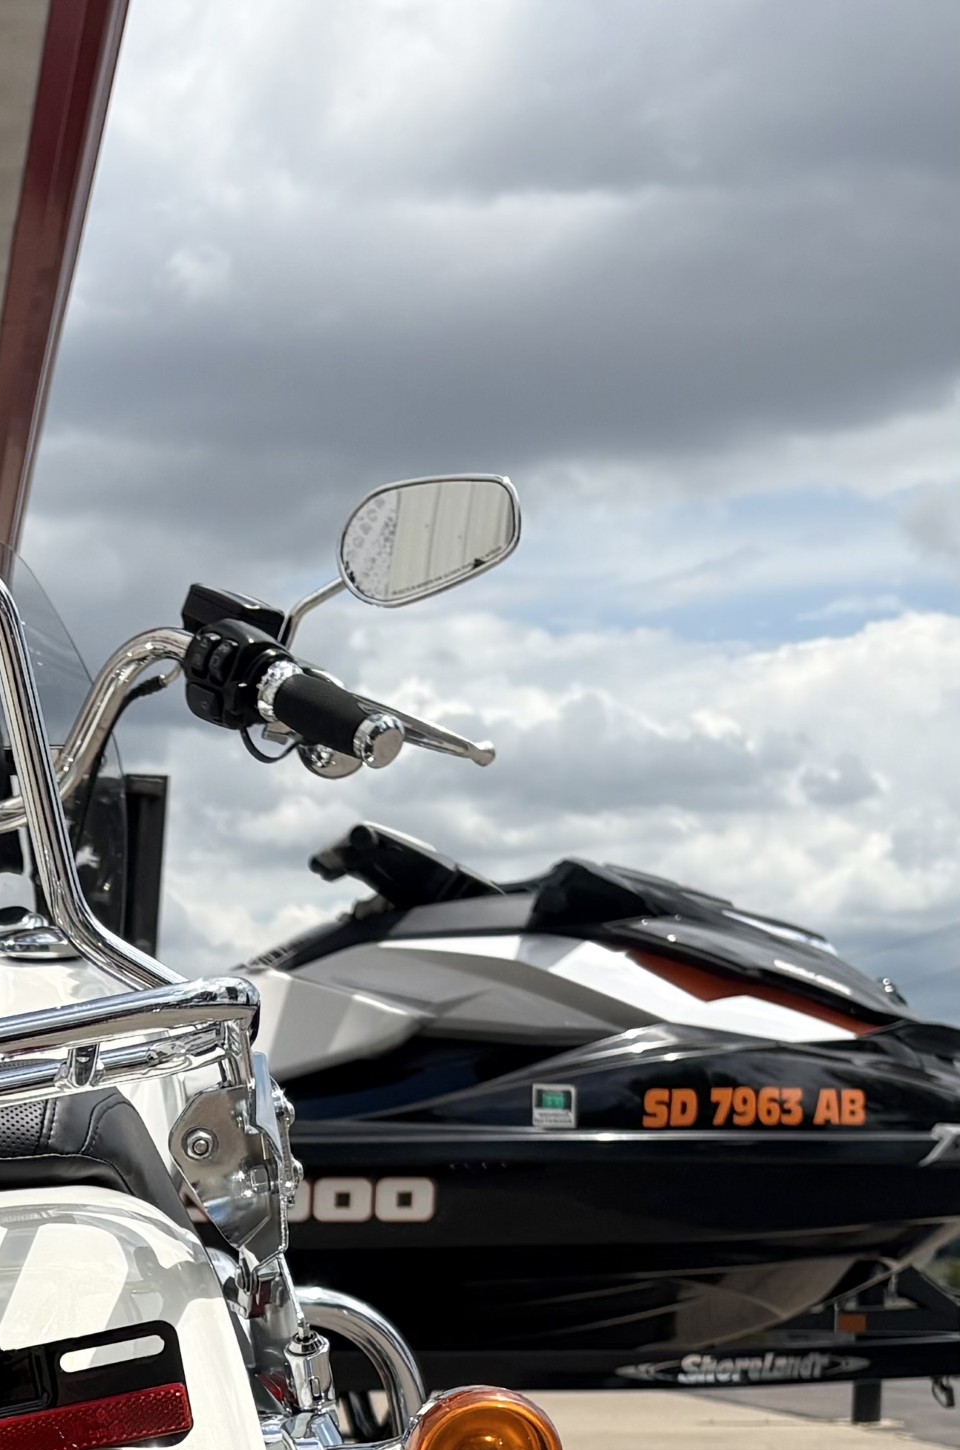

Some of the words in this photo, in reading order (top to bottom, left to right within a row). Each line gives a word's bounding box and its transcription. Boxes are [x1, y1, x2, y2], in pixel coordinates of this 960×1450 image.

[642, 1088, 698, 1128] SD
[710, 1087, 803, 1127] 7963
[813, 1088, 866, 1127] AB
